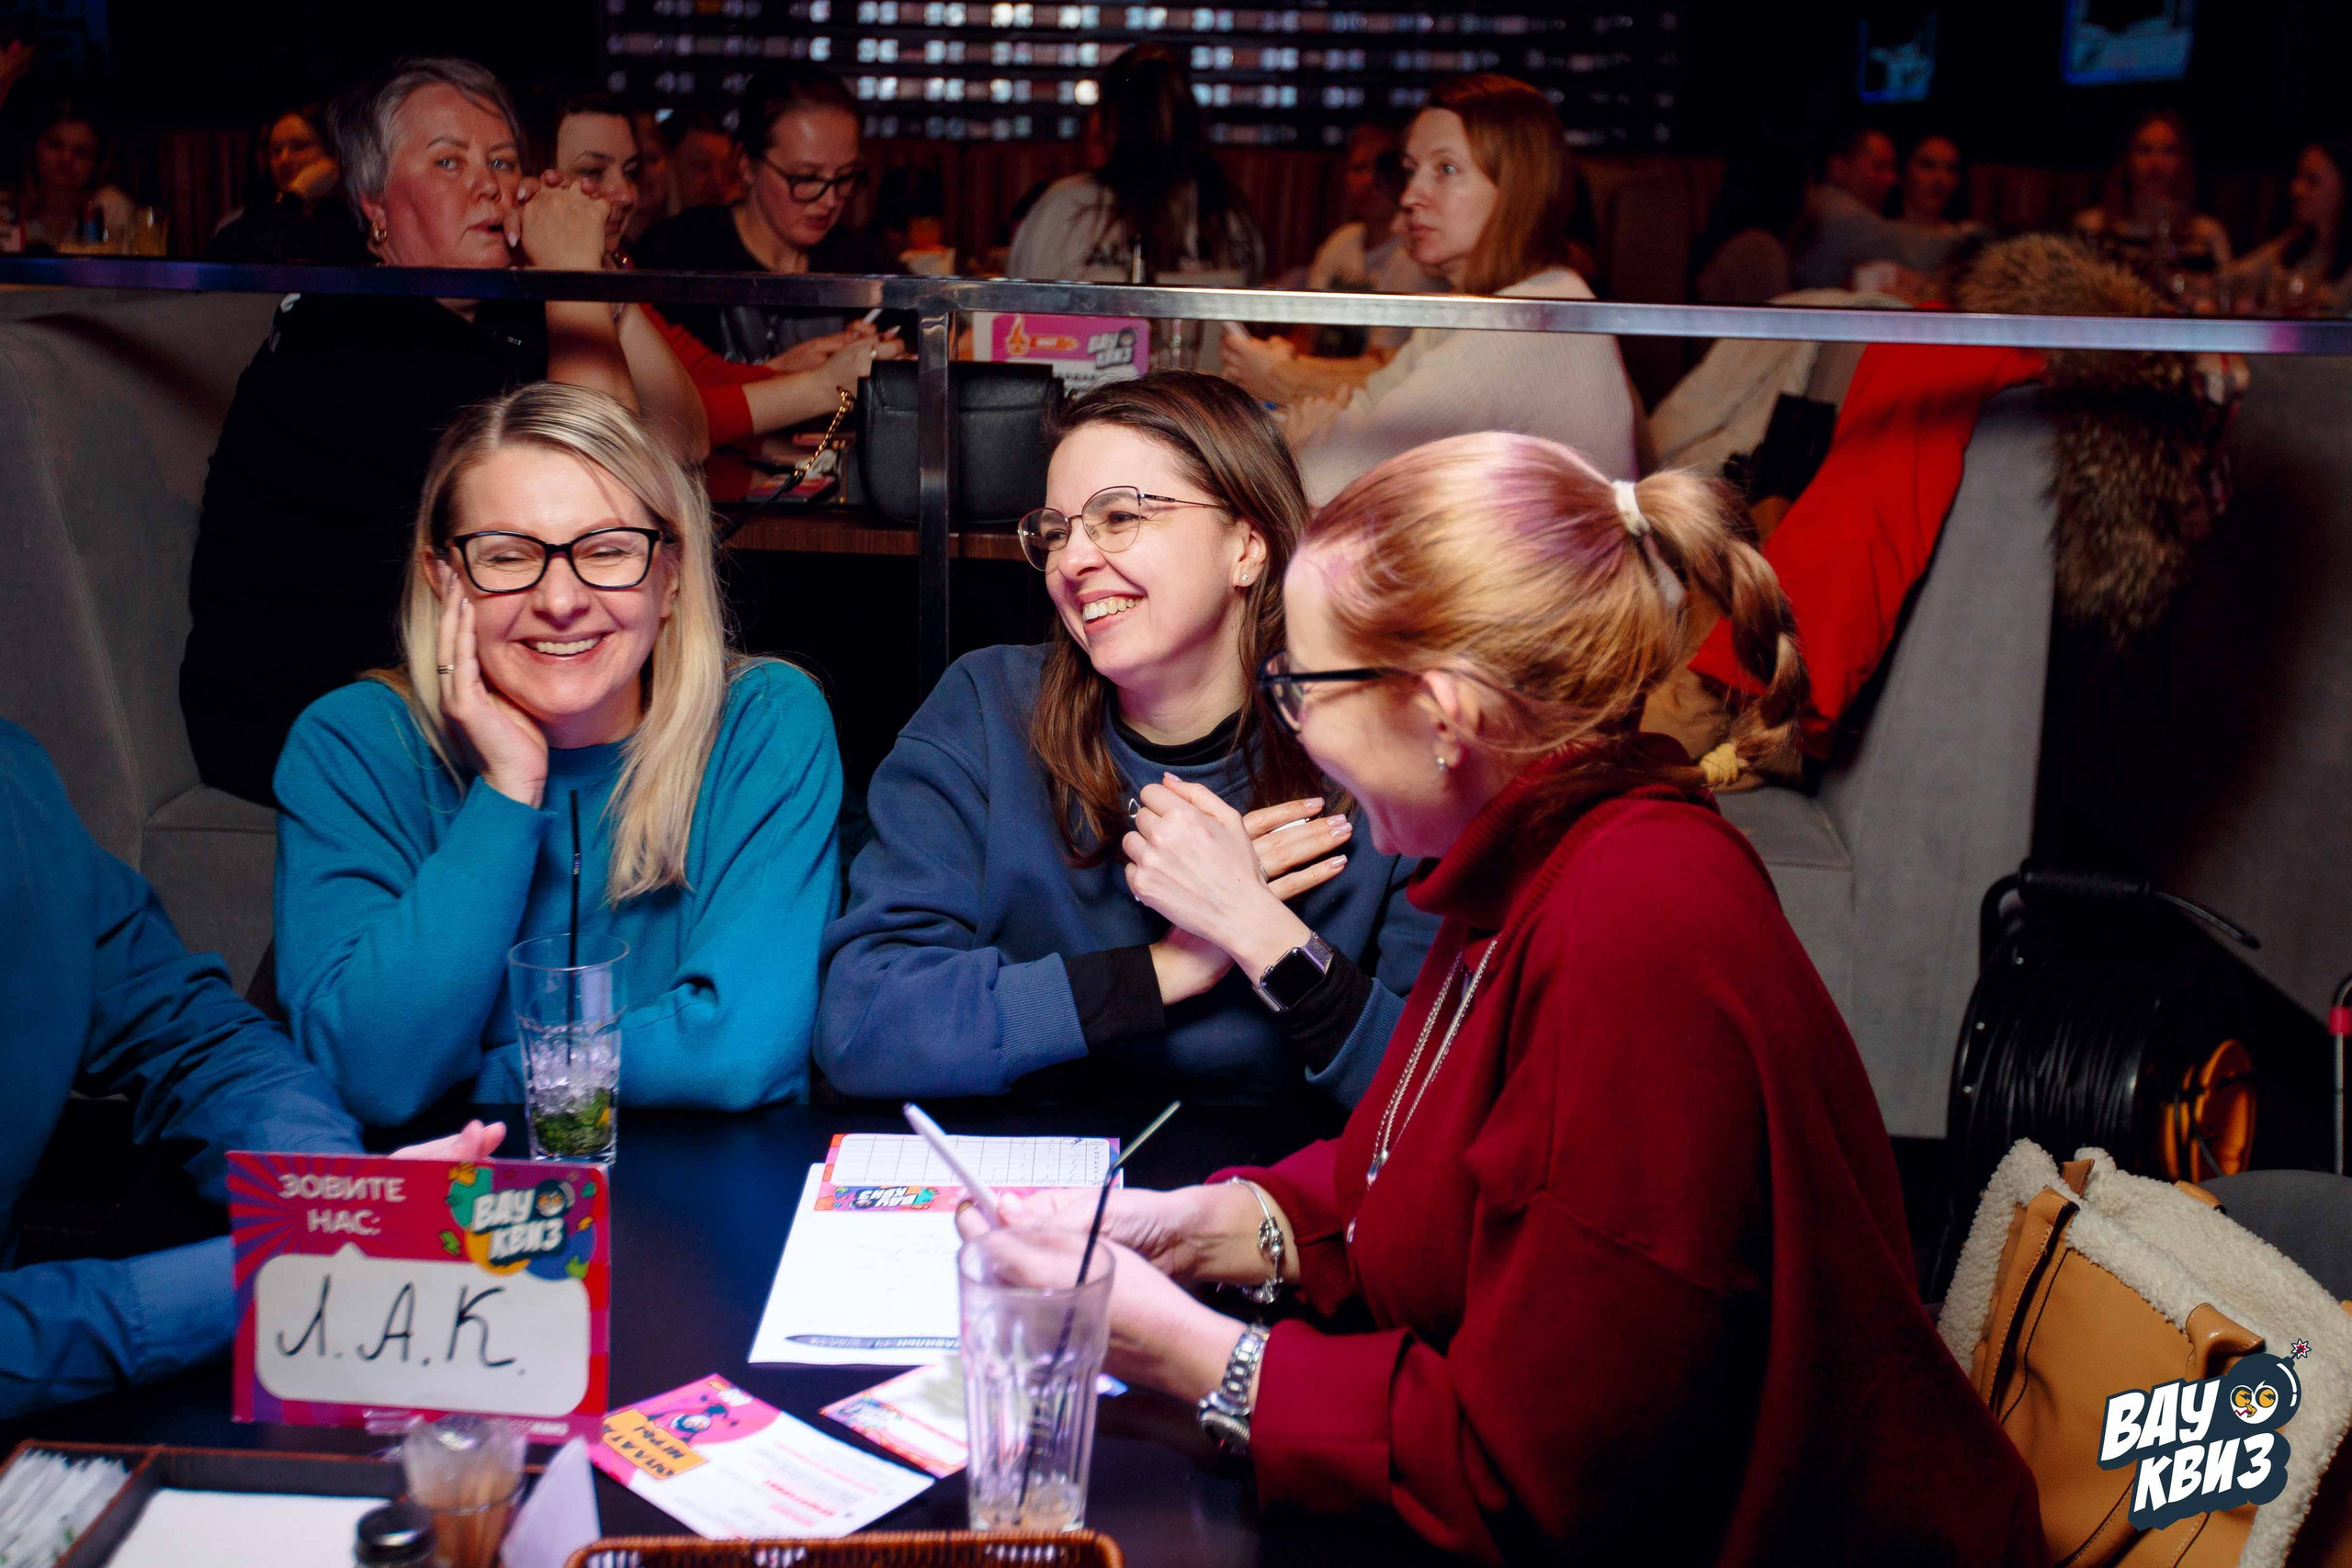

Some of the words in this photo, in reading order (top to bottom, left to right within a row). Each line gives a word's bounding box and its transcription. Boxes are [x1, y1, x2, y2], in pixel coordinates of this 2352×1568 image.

[277, 1173, 407, 1202] ЗОВИТЕ
[306, 1208, 381, 1235] НАС:
[472, 1189, 535, 1232] ВАУ
[489, 1218, 563, 1259] КВИЗ
